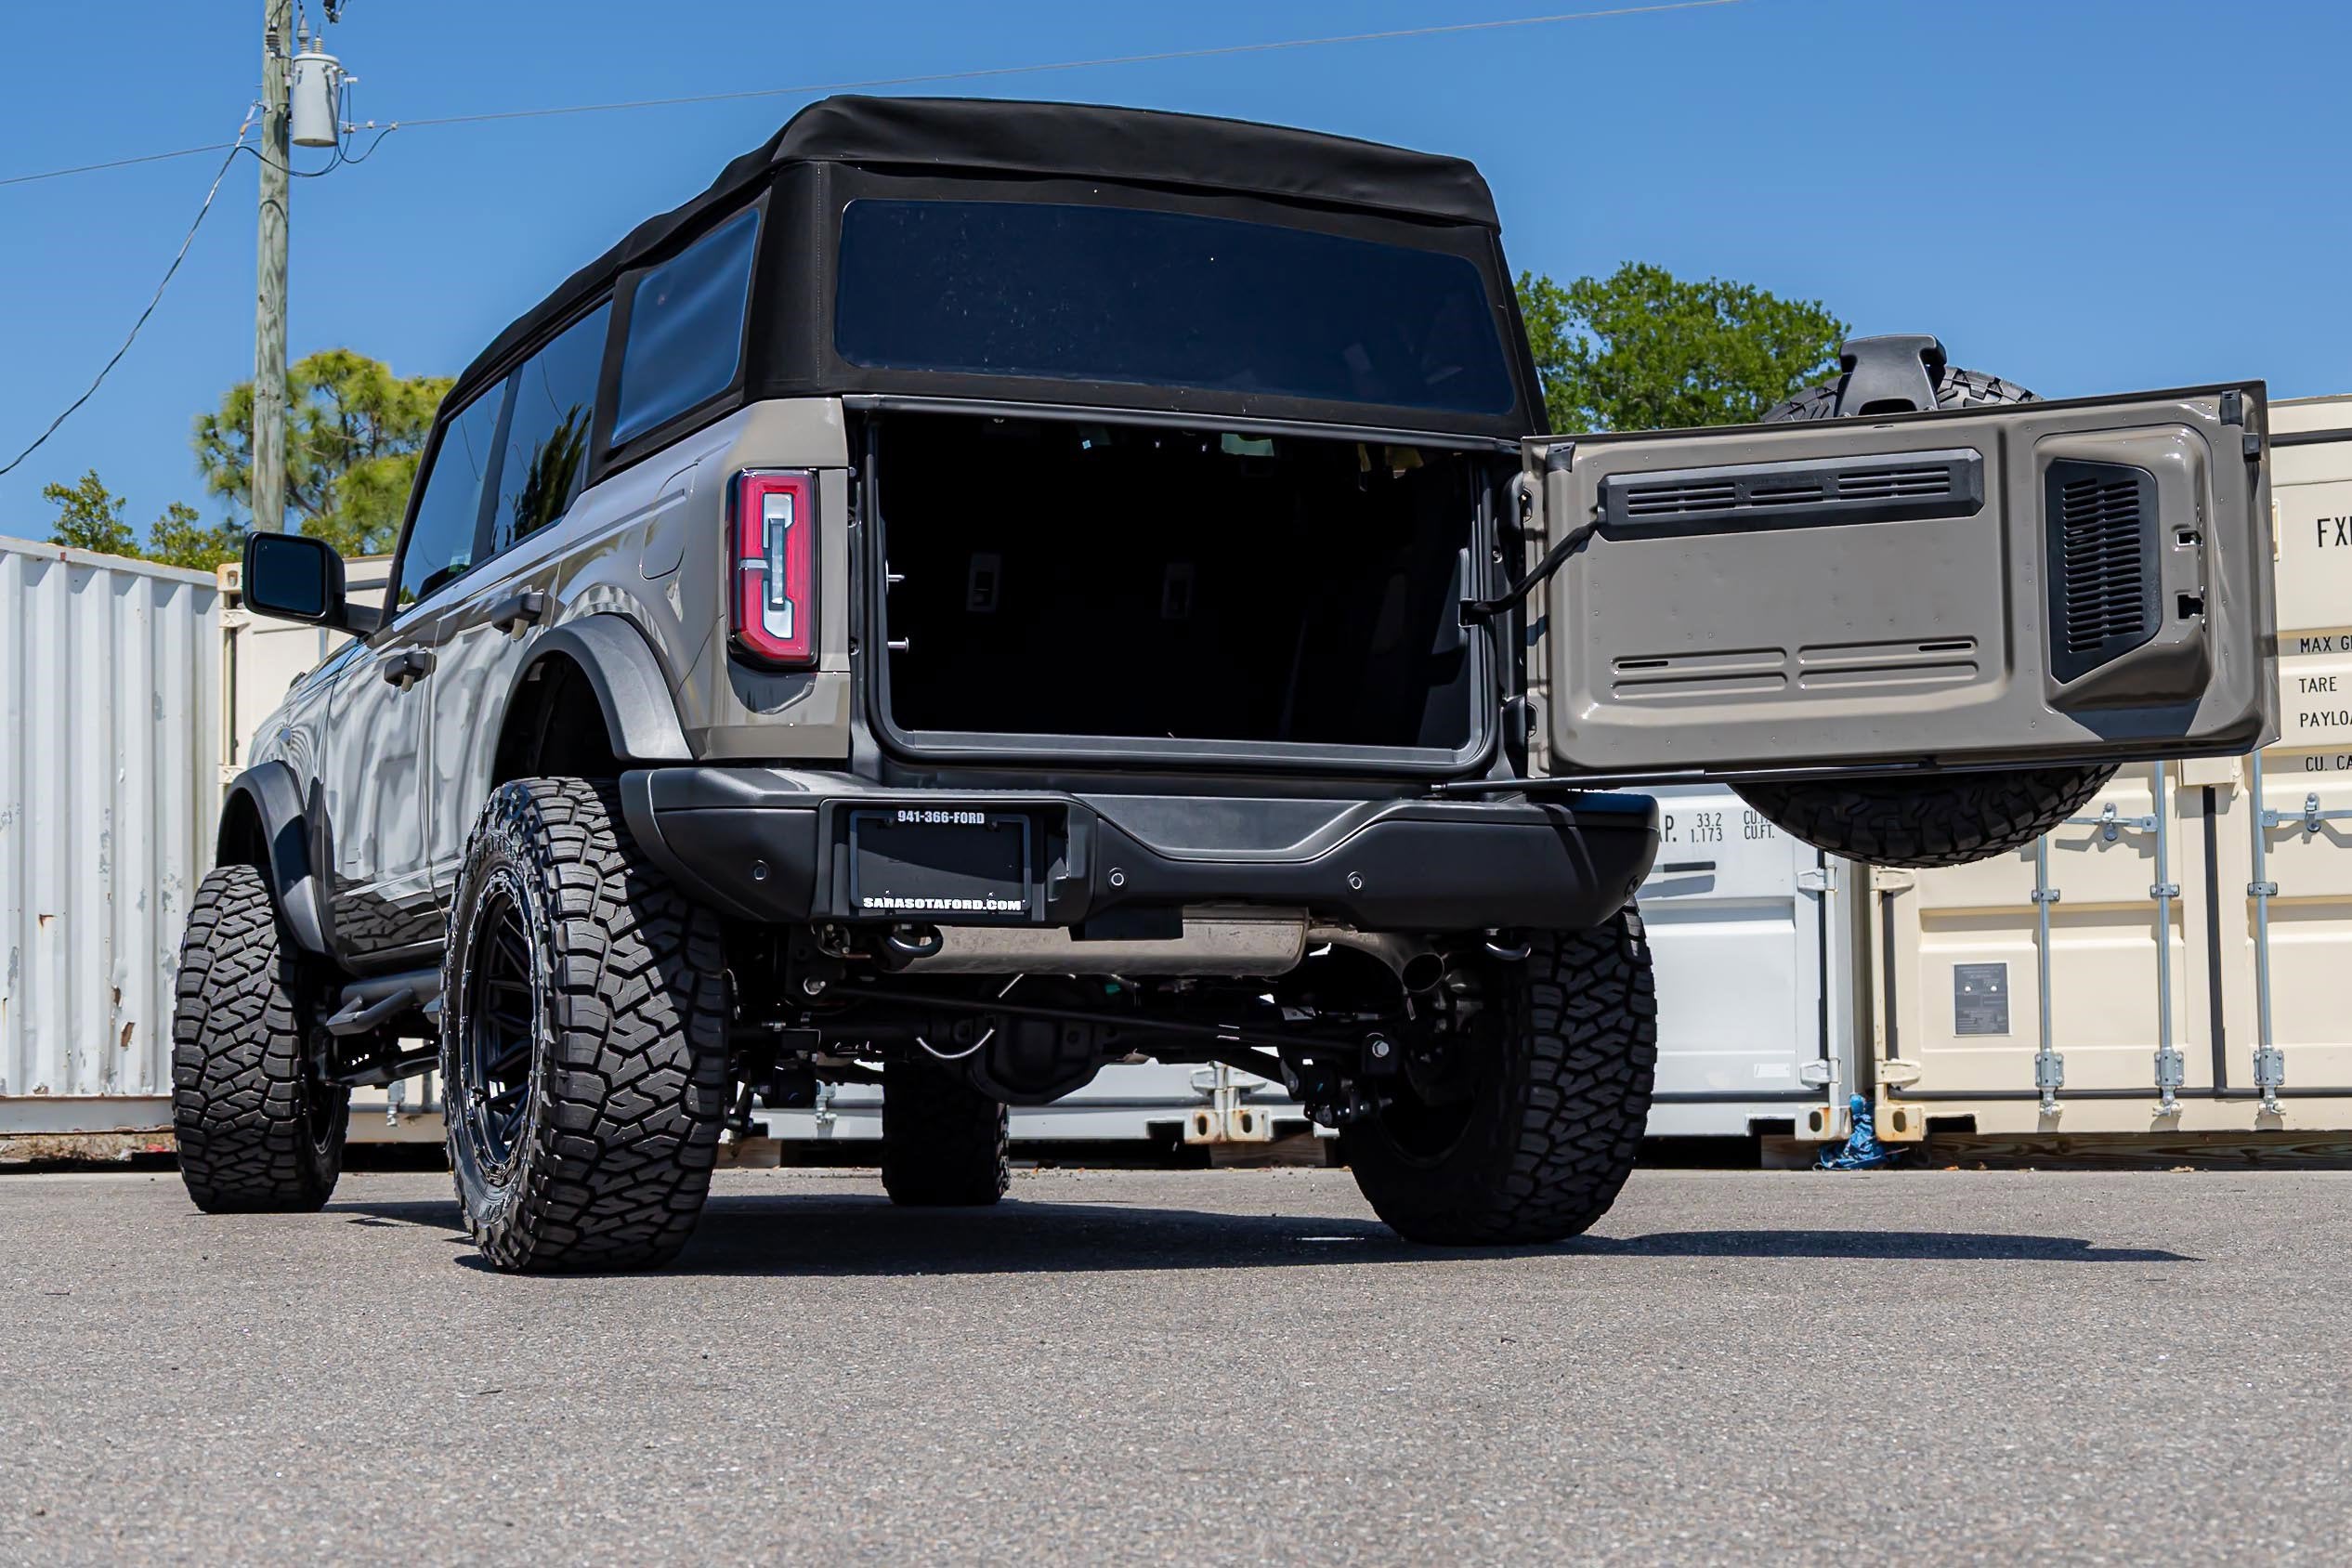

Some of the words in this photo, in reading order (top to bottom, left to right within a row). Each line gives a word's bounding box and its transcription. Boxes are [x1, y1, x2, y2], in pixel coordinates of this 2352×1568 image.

[2318, 516, 2352, 548] FX
[2300, 636, 2332, 653] MAX
[2341, 635, 2352, 651] G
[2298, 676, 2337, 694] TARE
[2300, 711, 2352, 728] PAYLO
[2306, 755, 2328, 772] CU.
[897, 810, 985, 824] 941-366-FORD
[1696, 812, 1722, 828] 33.2
[1659, 815, 1677, 843] P.
[1744, 824, 1775, 840] CU.FT.
[863, 896, 1022, 911] SARASOTAFORD.COM
